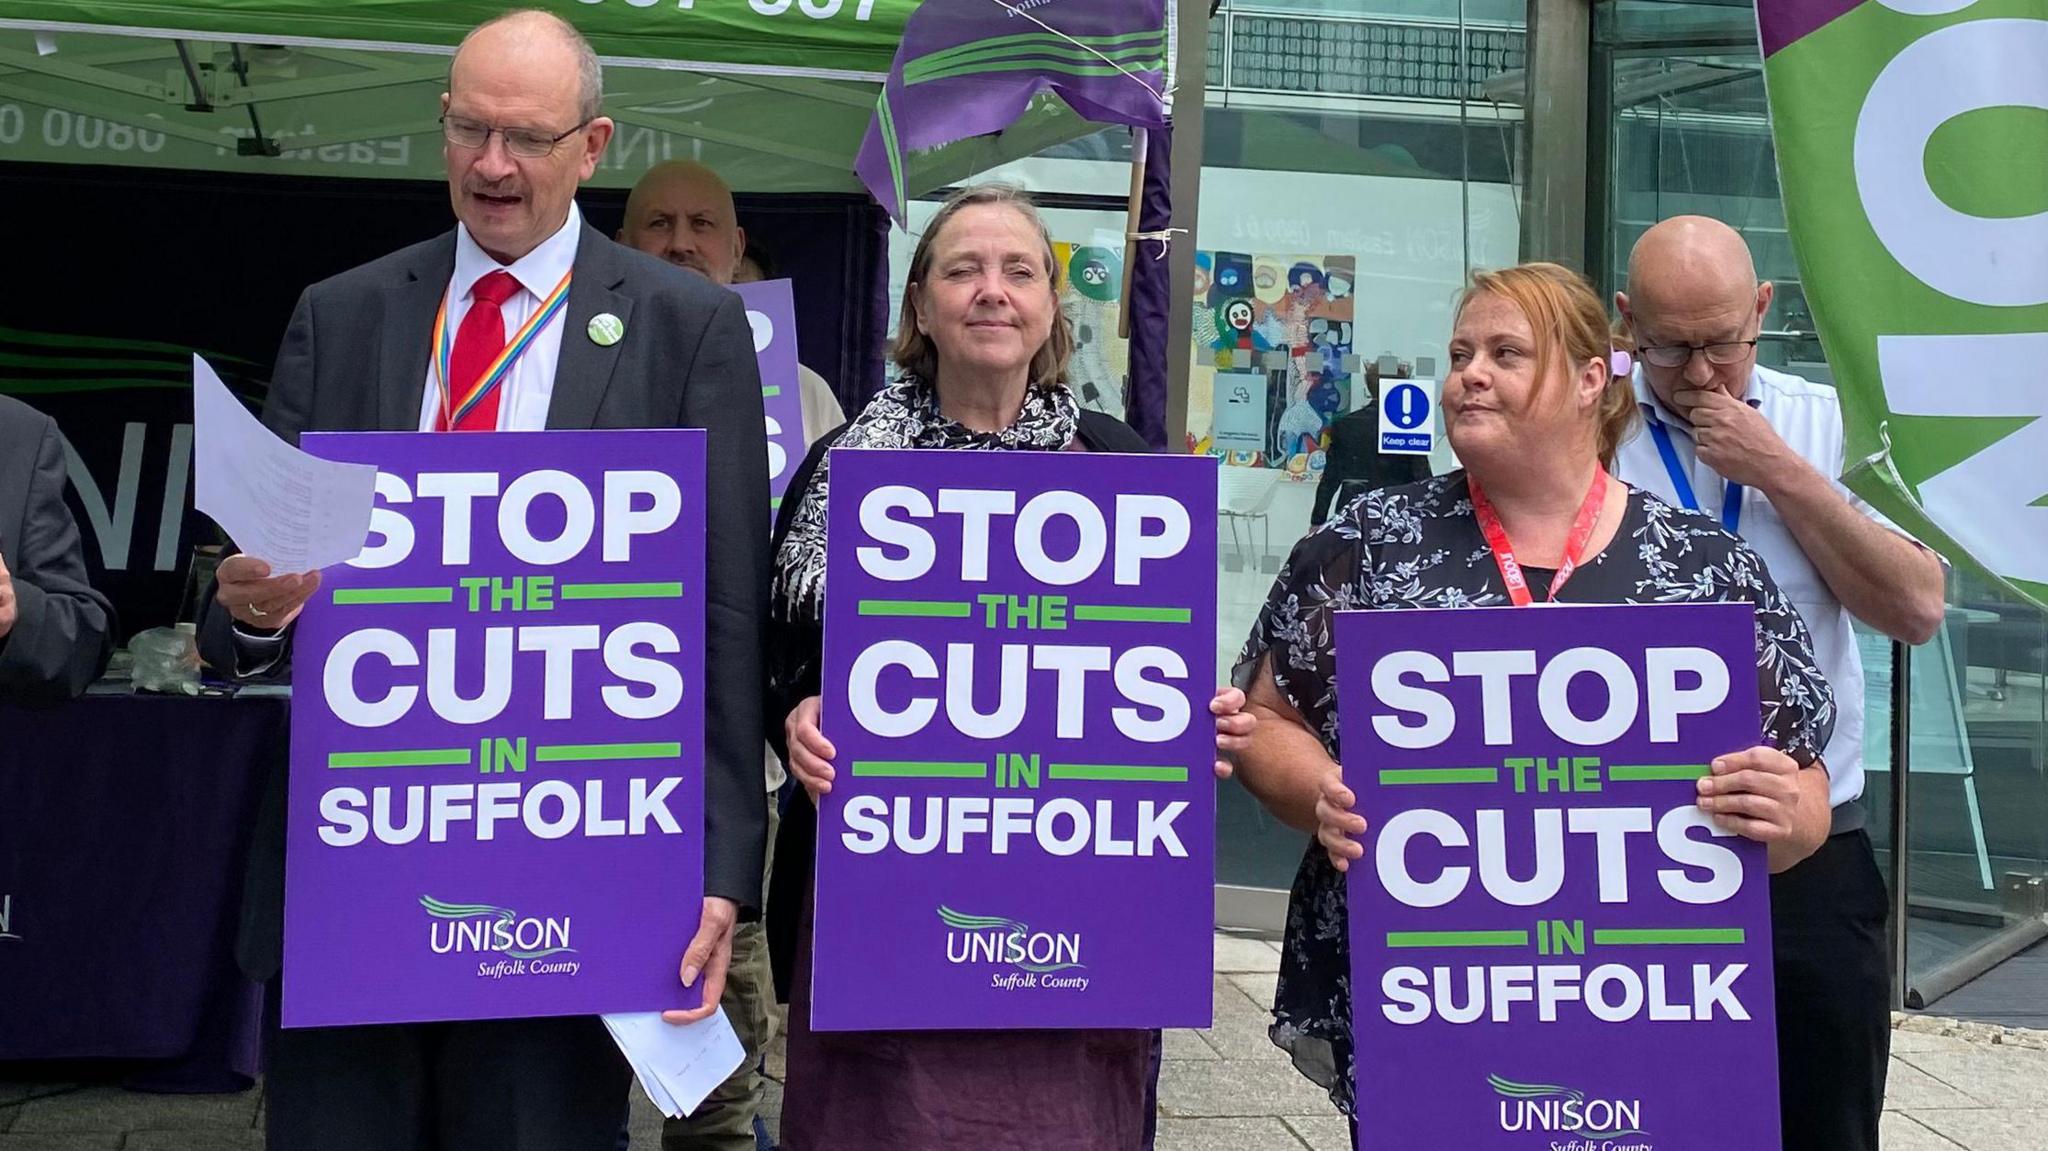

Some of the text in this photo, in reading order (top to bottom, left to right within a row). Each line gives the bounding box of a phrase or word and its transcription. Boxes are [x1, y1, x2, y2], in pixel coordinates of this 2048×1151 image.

[1383, 436, 1430, 447] Keep clear
[344, 470, 682, 569] STOP
[856, 485, 1191, 586] STOP
[461, 576, 554, 611] THE
[978, 594, 1068, 629] THE
[322, 621, 684, 728] CUTS
[848, 639, 1191, 743] CUTS
[1371, 646, 1731, 750] STOP
[480, 738, 528, 773] IN
[996, 754, 1041, 788] IN
[1504, 757, 1602, 792] THE
[318, 776, 684, 847] SUFFOLK
[841, 796, 1190, 857] SUFFOLK
[1375, 804, 1744, 908] CUTS
[430, 917, 571, 954] UNISON
[946, 932, 1080, 964] UNISON
[1537, 920, 1586, 955] IN
[477, 958, 581, 979] Suffolk County
[991, 973, 1090, 991] Suffolk County
[1381, 963, 1751, 1025] SUFFOLK
[1500, 1099, 1640, 1132] UNISON
